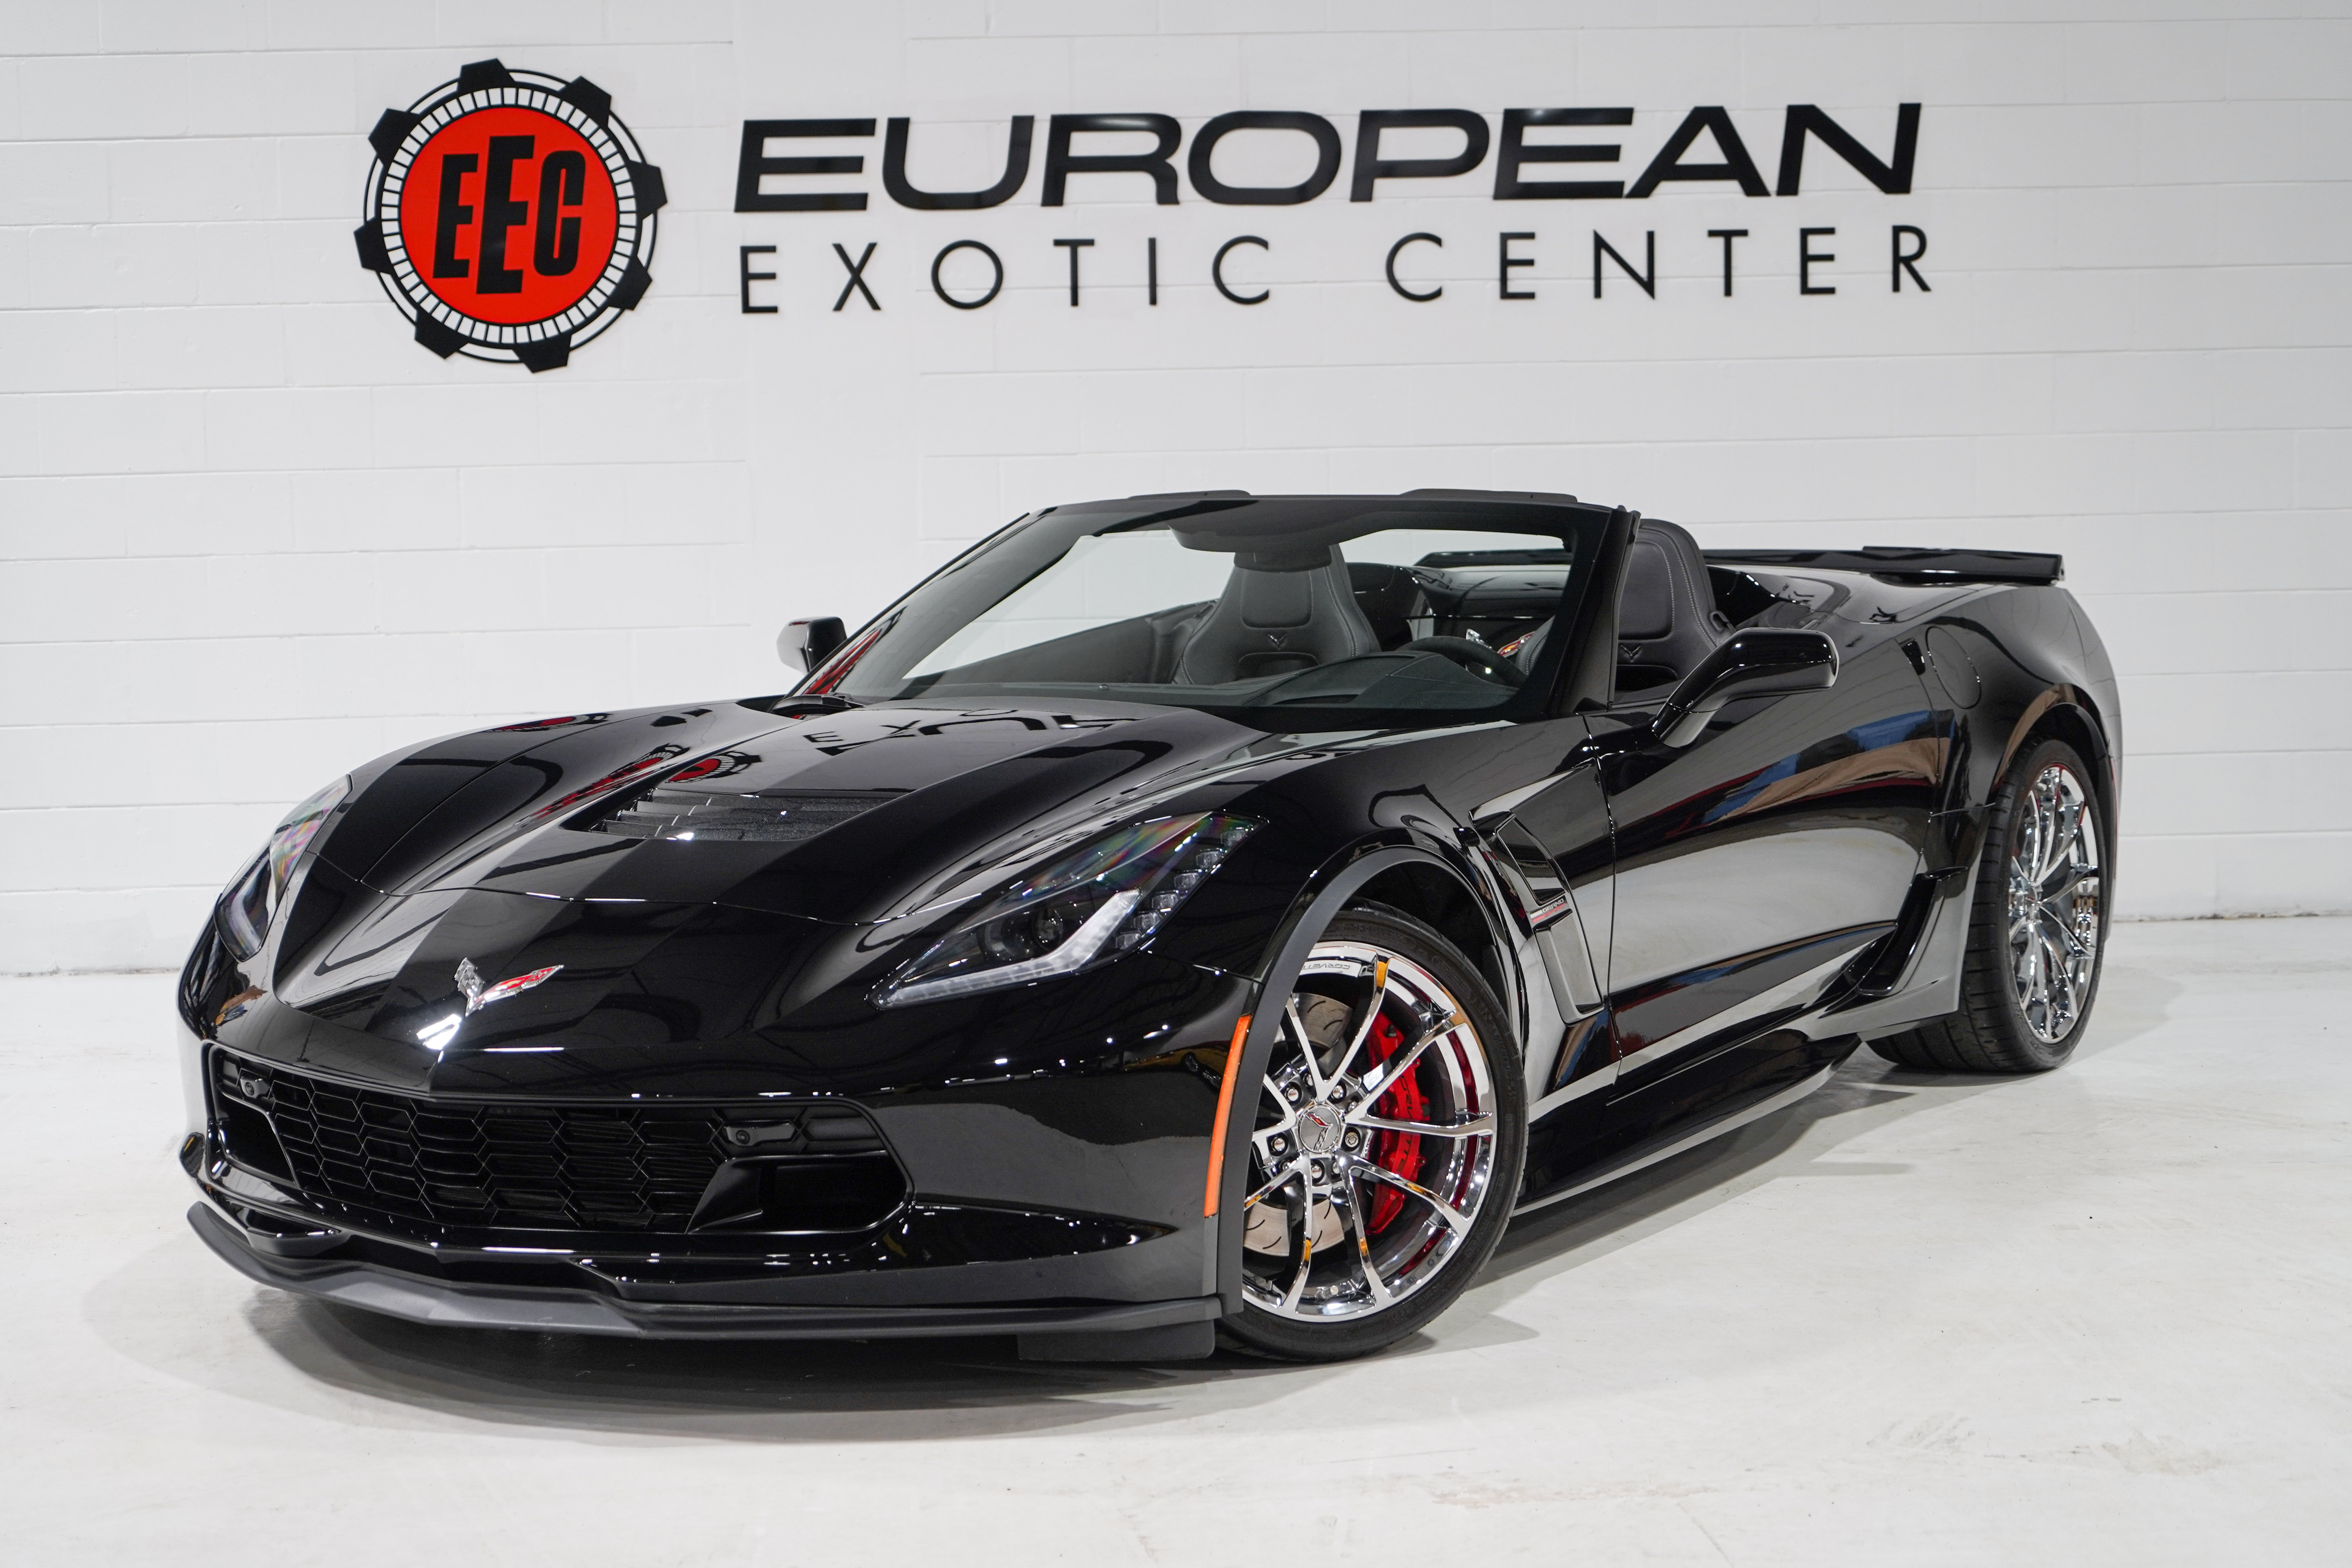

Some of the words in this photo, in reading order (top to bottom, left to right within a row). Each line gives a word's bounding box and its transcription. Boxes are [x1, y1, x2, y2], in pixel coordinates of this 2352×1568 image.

[735, 103, 1921, 212] EUROPEAN
[433, 135, 586, 294] EEC
[741, 236, 1269, 314] EXOTIC
[1387, 226, 1931, 302] CENTER
[1542, 898, 1564, 913] GRAND
